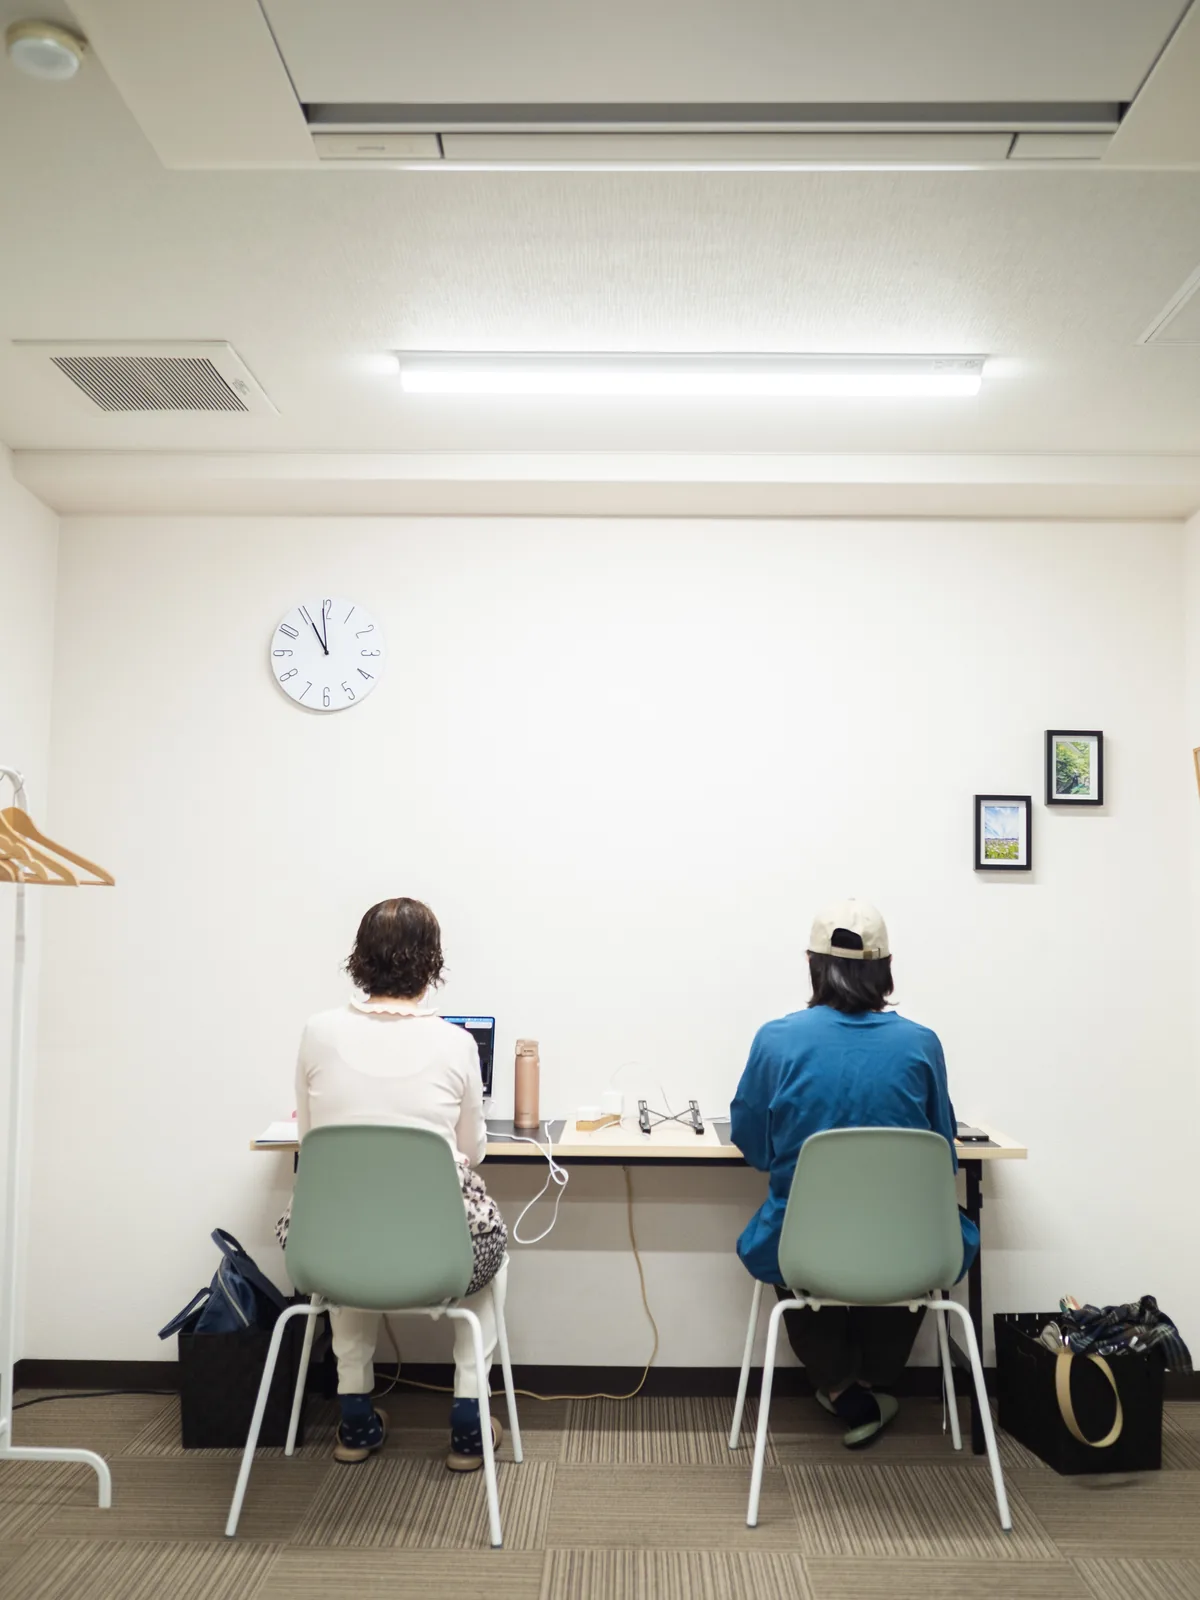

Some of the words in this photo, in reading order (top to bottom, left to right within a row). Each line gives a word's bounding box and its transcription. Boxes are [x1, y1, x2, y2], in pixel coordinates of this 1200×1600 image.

[298, 605, 313, 625] 11
[344, 606, 355, 624] 1
[279, 623, 300, 640] 10
[355, 624, 375, 639] 2
[273, 649, 293, 657] 9
[361, 649, 381, 657] 3
[279, 668, 299, 682] 8
[356, 668, 375, 680] 4
[299, 681, 313, 701] 7
[323, 687, 331, 708] 6
[341, 681, 355, 701] 5
